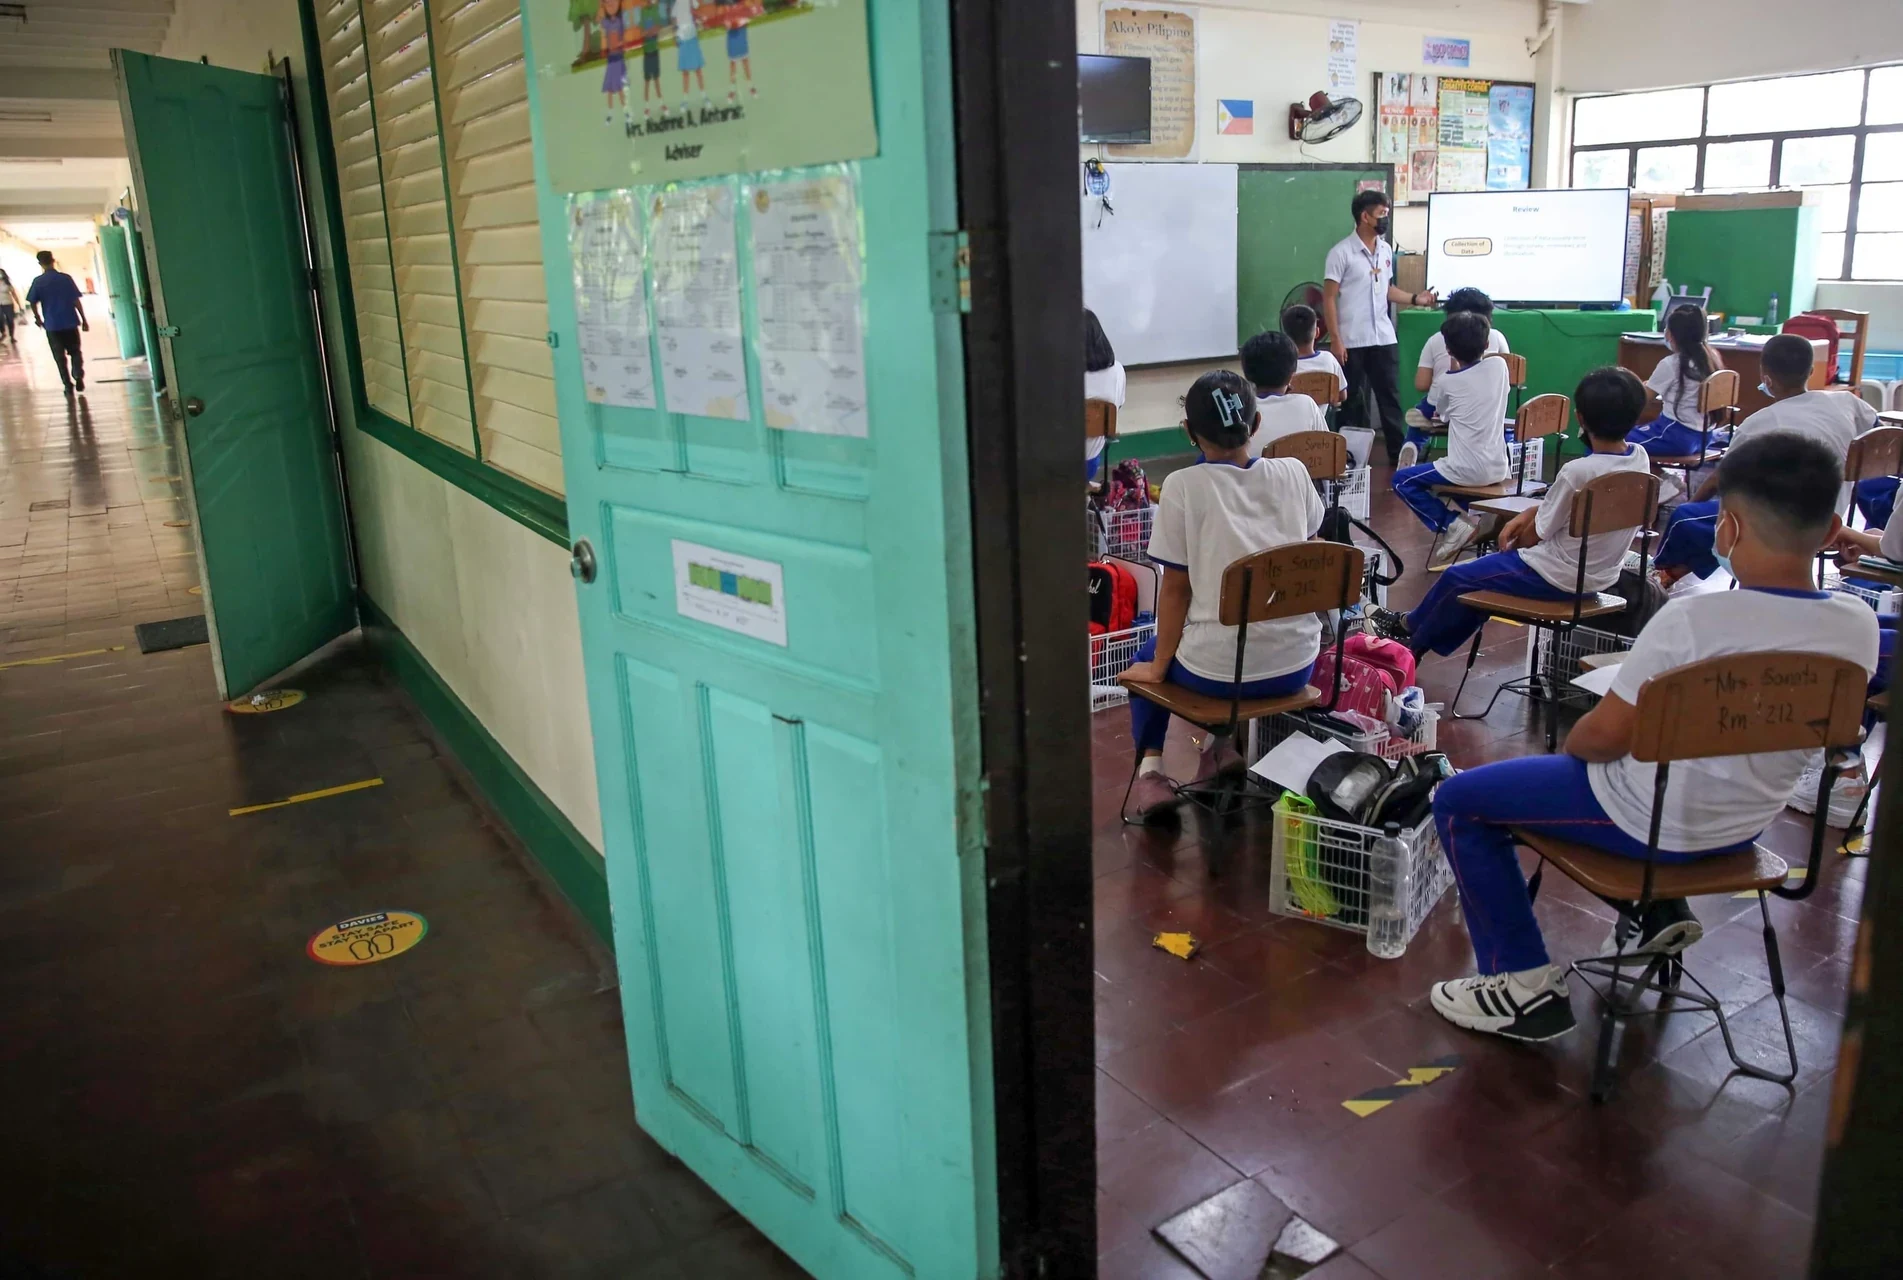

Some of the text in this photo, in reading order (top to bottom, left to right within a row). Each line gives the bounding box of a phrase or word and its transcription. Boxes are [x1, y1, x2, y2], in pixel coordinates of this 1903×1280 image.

[1109, 20, 1191, 40] Ako'y Pilipino
[1764, 702, 1795, 725] 212
[332, 919, 400, 940] STAY SAFE
[339, 914, 385, 930] DAVIES
[318, 937, 350, 949] STAY
[373, 920, 415, 936] APART
